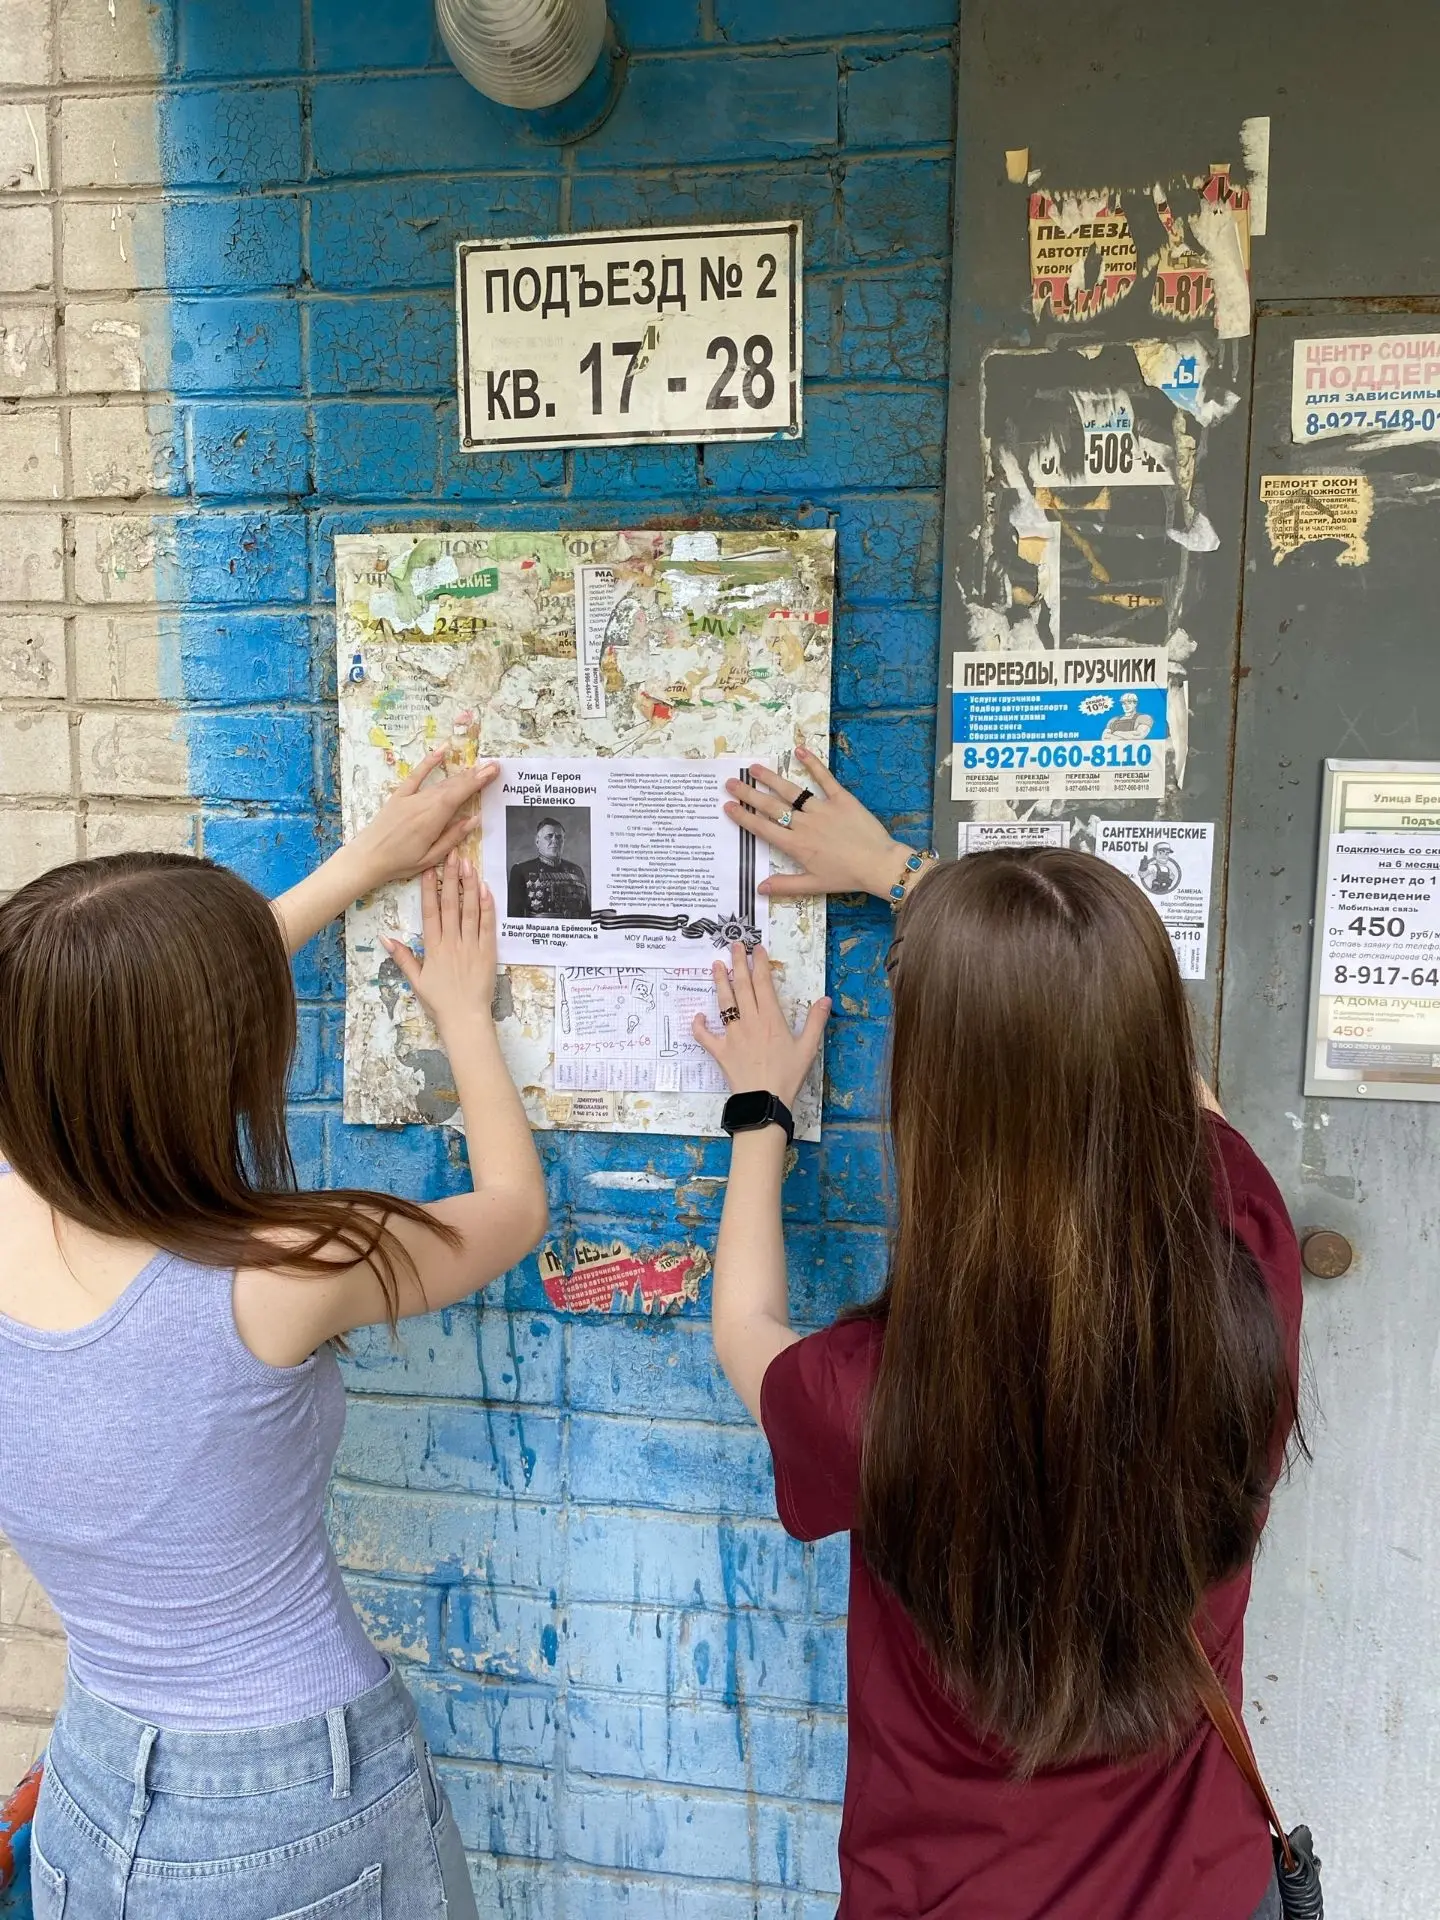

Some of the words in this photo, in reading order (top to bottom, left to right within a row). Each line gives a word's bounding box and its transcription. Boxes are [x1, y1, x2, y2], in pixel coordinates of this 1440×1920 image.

[485, 258, 687, 320] ПОДЪЕЗД
[700, 256, 743, 302] №
[756, 253, 777, 299] 2
[1307, 344, 1372, 366] ЦЕНТР
[1379, 341, 1440, 360] СОЦИА
[487, 368, 556, 421] КВ.
[579, 341, 645, 415] 17
[705, 334, 776, 411] 28
[1305, 362, 1440, 391] ПОДДЕР
[1305, 393, 1340, 405] ДЛЯ
[1306, 408, 1440, 436] 8-927-548-0
[1265, 480, 1318, 488] РЕМОНТ
[1322, 479, 1357, 487] ОКОН
[964, 660, 1058, 687] ПЕРЕЕЗДЫ,
[1064, 658, 1156, 685] ГРУЗЧИКИ
[970, 705, 1000, 713] Подбор
[1002, 704, 1068, 712] автотранспорта
[1086, 702, 1108, 712] 10%
[970, 714, 1019, 722] Утилизация
[1006, 732, 1046, 740] разборка
[1047, 731, 1079, 739] мебели
[963, 744, 1152, 769] 8-927-060-8110
[518, 772, 548, 781] Улица
[551, 772, 581, 782] Героя
[502, 784, 541, 794] Андрей
[545, 784, 597, 794] Иванович
[523, 795, 576, 807] Ерёменко
[1374, 794, 1411, 804] Улица
[1102, 827, 1206, 839] САНТЕХНИЧЕСКИЕ
[1102, 840, 1148, 853] РАБОТЫ
[1336, 845, 1405, 854] Подключись
[1341, 874, 1405, 885] Интернет
[1408, 877, 1425, 886] до
[1340, 890, 1430, 901] Телевидение
[1338, 904, 1389, 912] Мобильная
[502, 923, 524, 932] Улица
[526, 924, 560, 932] Маршала
[1348, 916, 1405, 937] 450
[508, 931, 550, 939] Волгограде
[642, 934, 663, 942] Лицей
[1171, 931, 1200, 941] -8110
[549, 939, 568, 947] году.
[1363, 942, 1390, 950] заявку
[1329, 951, 1357, 959] форме
[1358, 953, 1419, 961] отсканировав
[1334, 965, 1440, 986] 8-917-64
[1334, 996, 1344, 1004] А
[1347, 998, 1388, 1007] дома
[1391, 999, 1440, 1010] лучше
[1333, 1026, 1365, 1036] 450
[563, 1034, 651, 1055] 8-927-502-54-68
[660, 1258, 679, 1269] 10%
